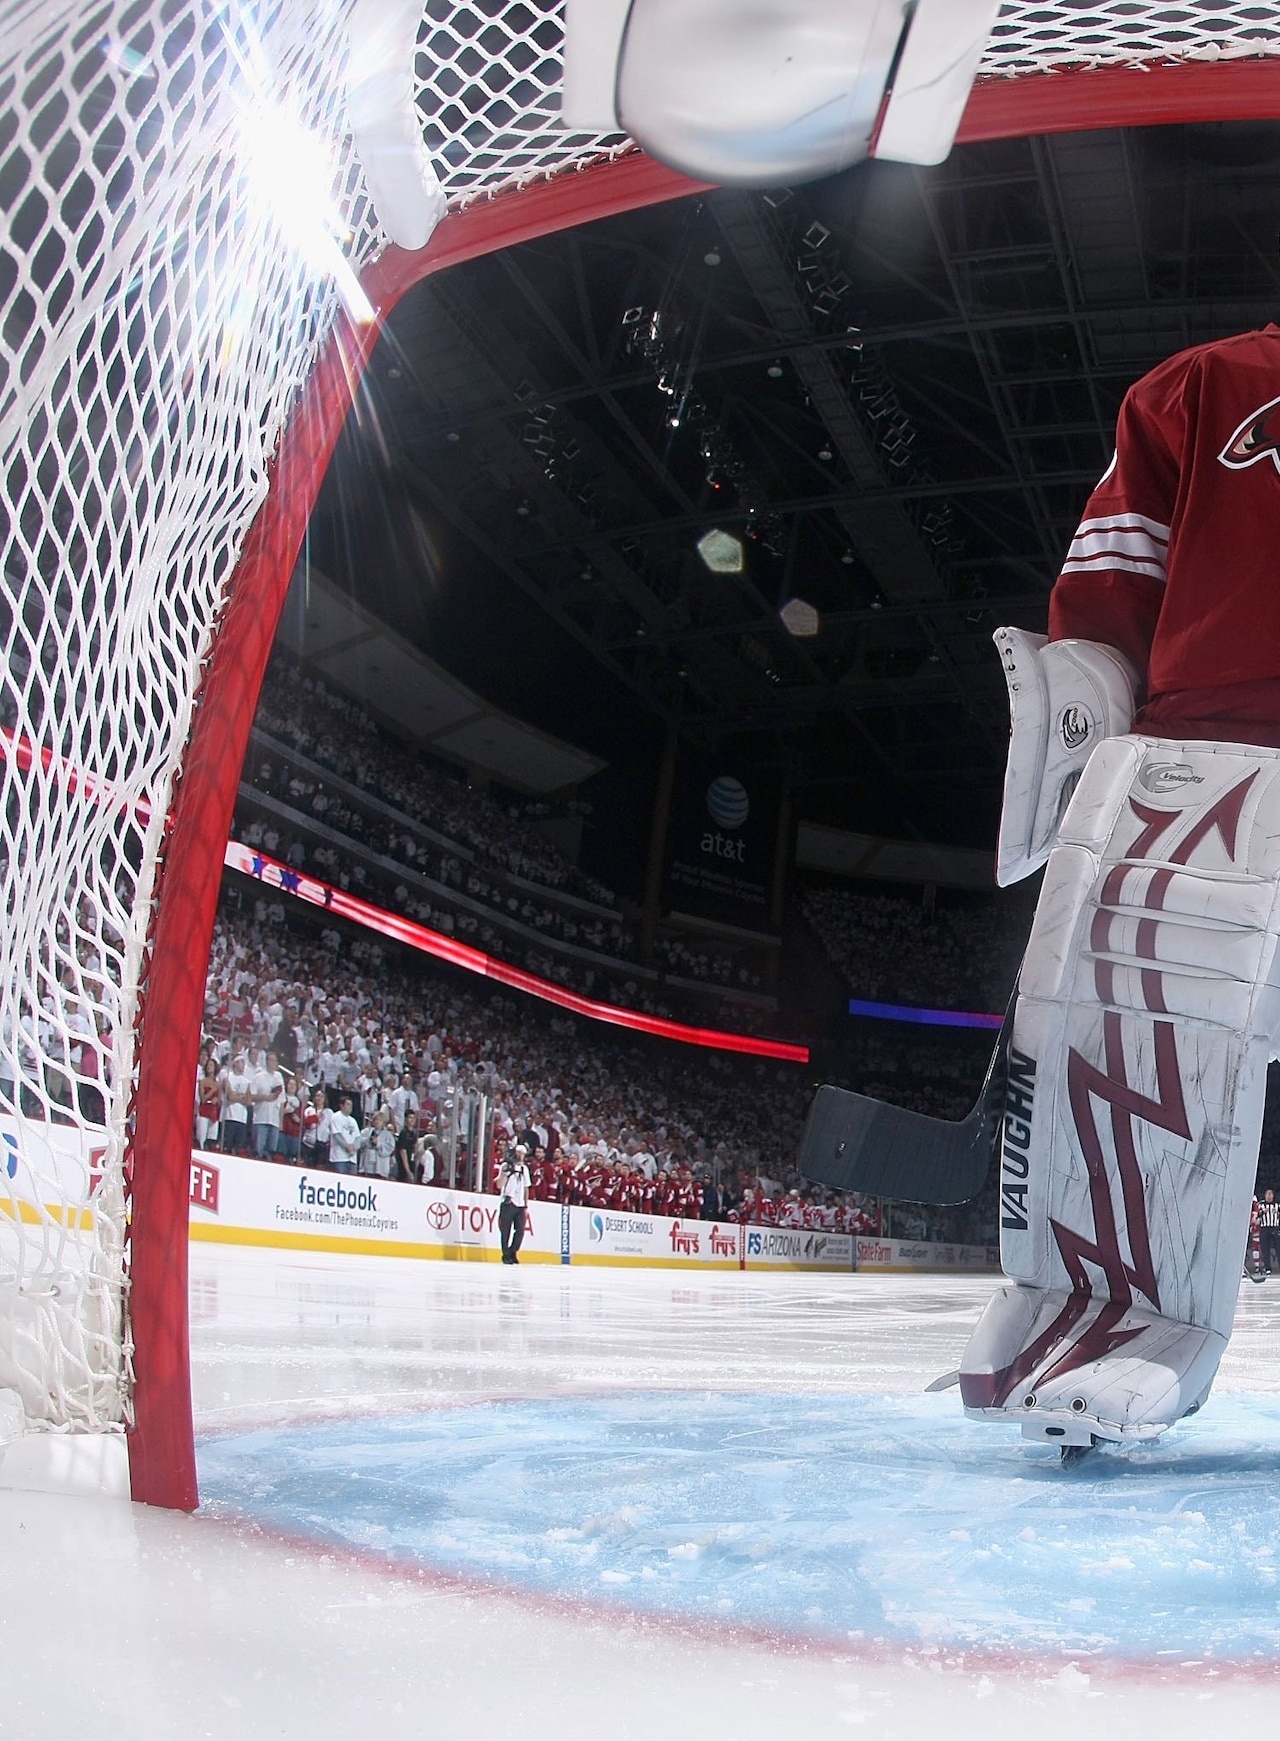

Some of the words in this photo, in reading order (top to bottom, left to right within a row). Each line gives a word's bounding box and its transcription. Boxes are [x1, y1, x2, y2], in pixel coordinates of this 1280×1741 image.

[1163, 772, 1205, 784] Velocity
[700, 832, 747, 863] at&t
[1002, 1050, 1038, 1231] VAUGHN
[299, 1176, 377, 1212] facebook
[458, 1205, 534, 1236] TOYA
[747, 1233, 762, 1255] FS
[761, 1234, 801, 1257] ARIZONA
